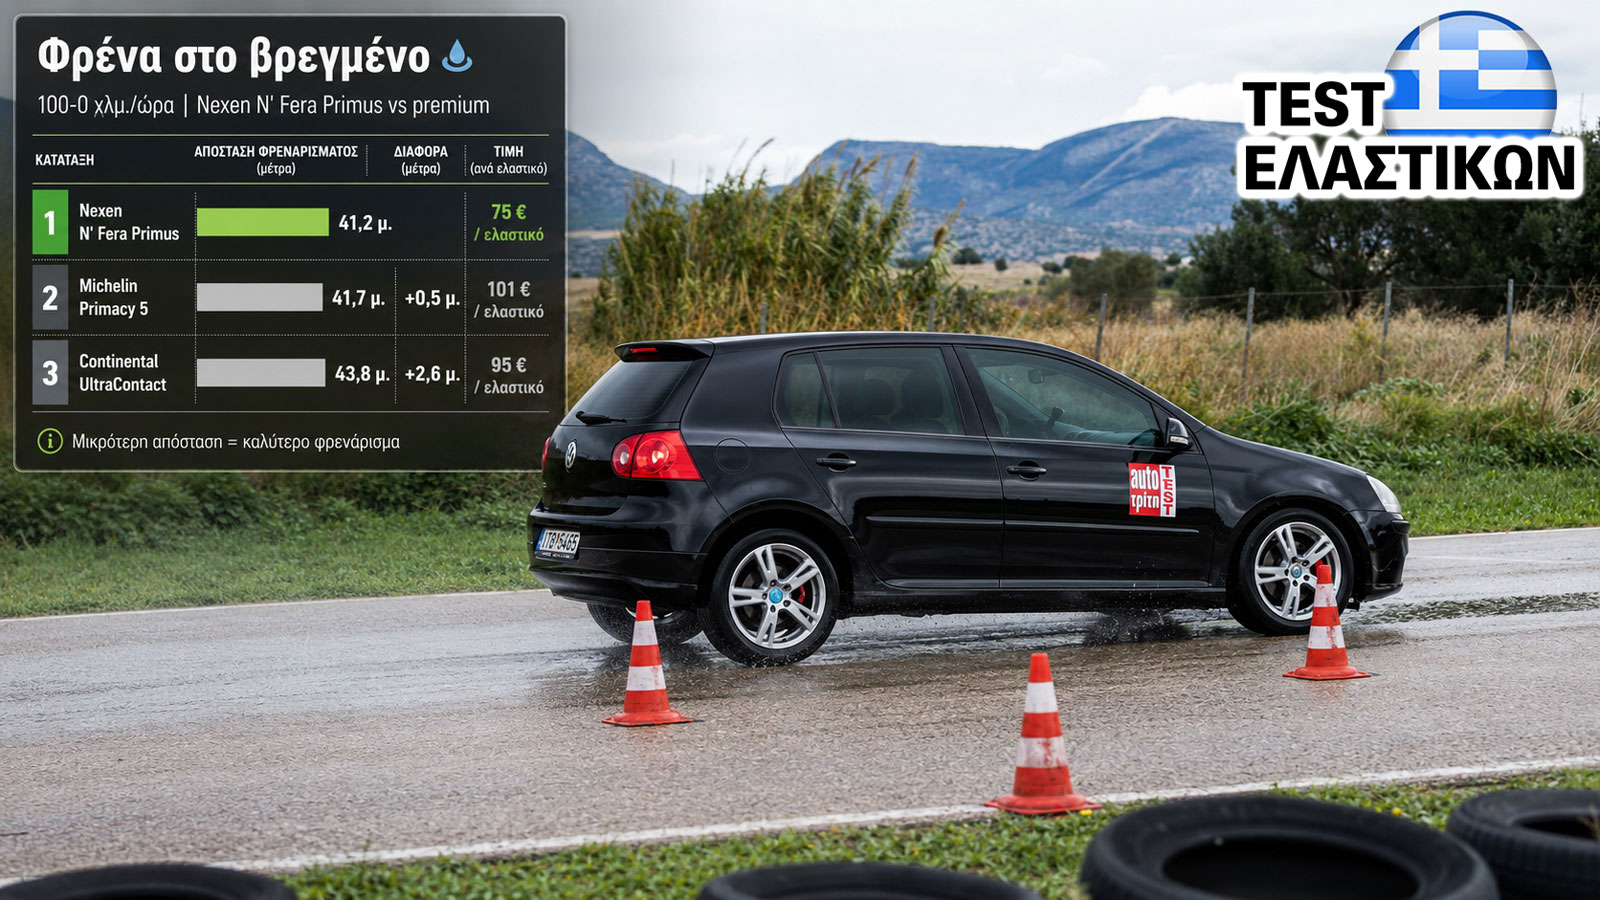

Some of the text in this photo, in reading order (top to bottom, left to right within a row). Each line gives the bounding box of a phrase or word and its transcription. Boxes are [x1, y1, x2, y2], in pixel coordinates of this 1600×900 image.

[1131, 466, 1159, 490] auto
[1131, 491, 1160, 513] τρίτη
[1161, 466, 1174, 515] TEST
